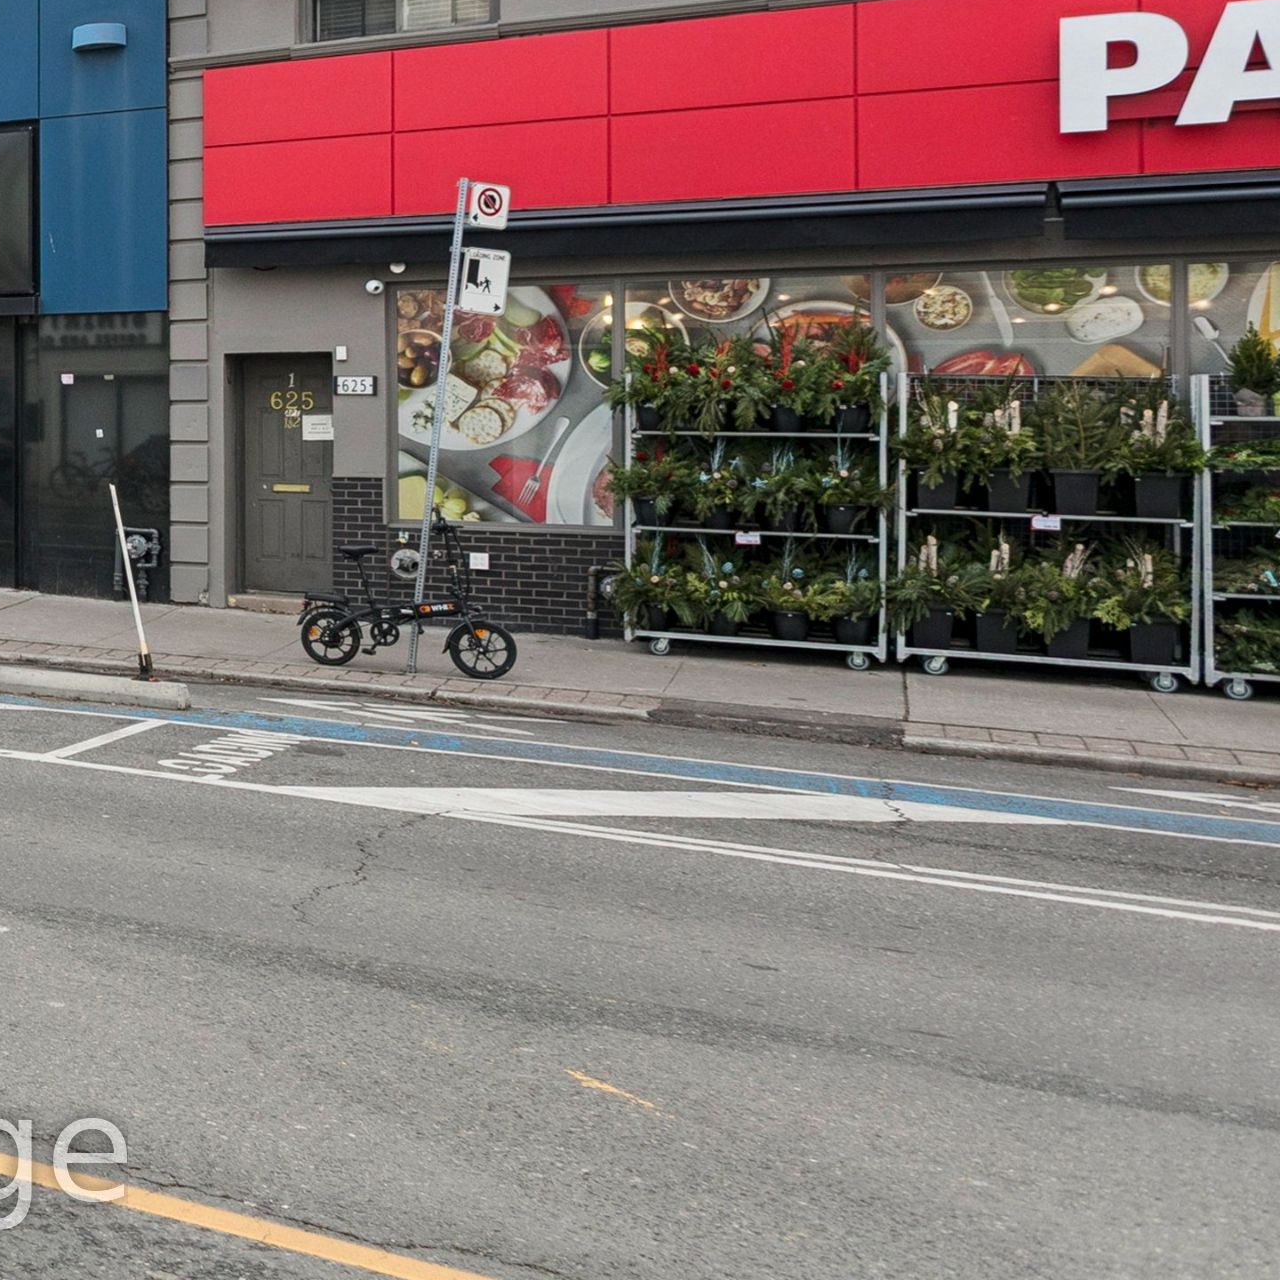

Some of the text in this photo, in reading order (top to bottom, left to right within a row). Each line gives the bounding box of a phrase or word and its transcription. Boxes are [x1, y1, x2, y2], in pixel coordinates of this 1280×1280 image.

[469, 251, 491, 259] LOADING
[288, 372, 295, 388] 1
[341, 379, 367, 392] 625
[270, 391, 314, 410] 625
